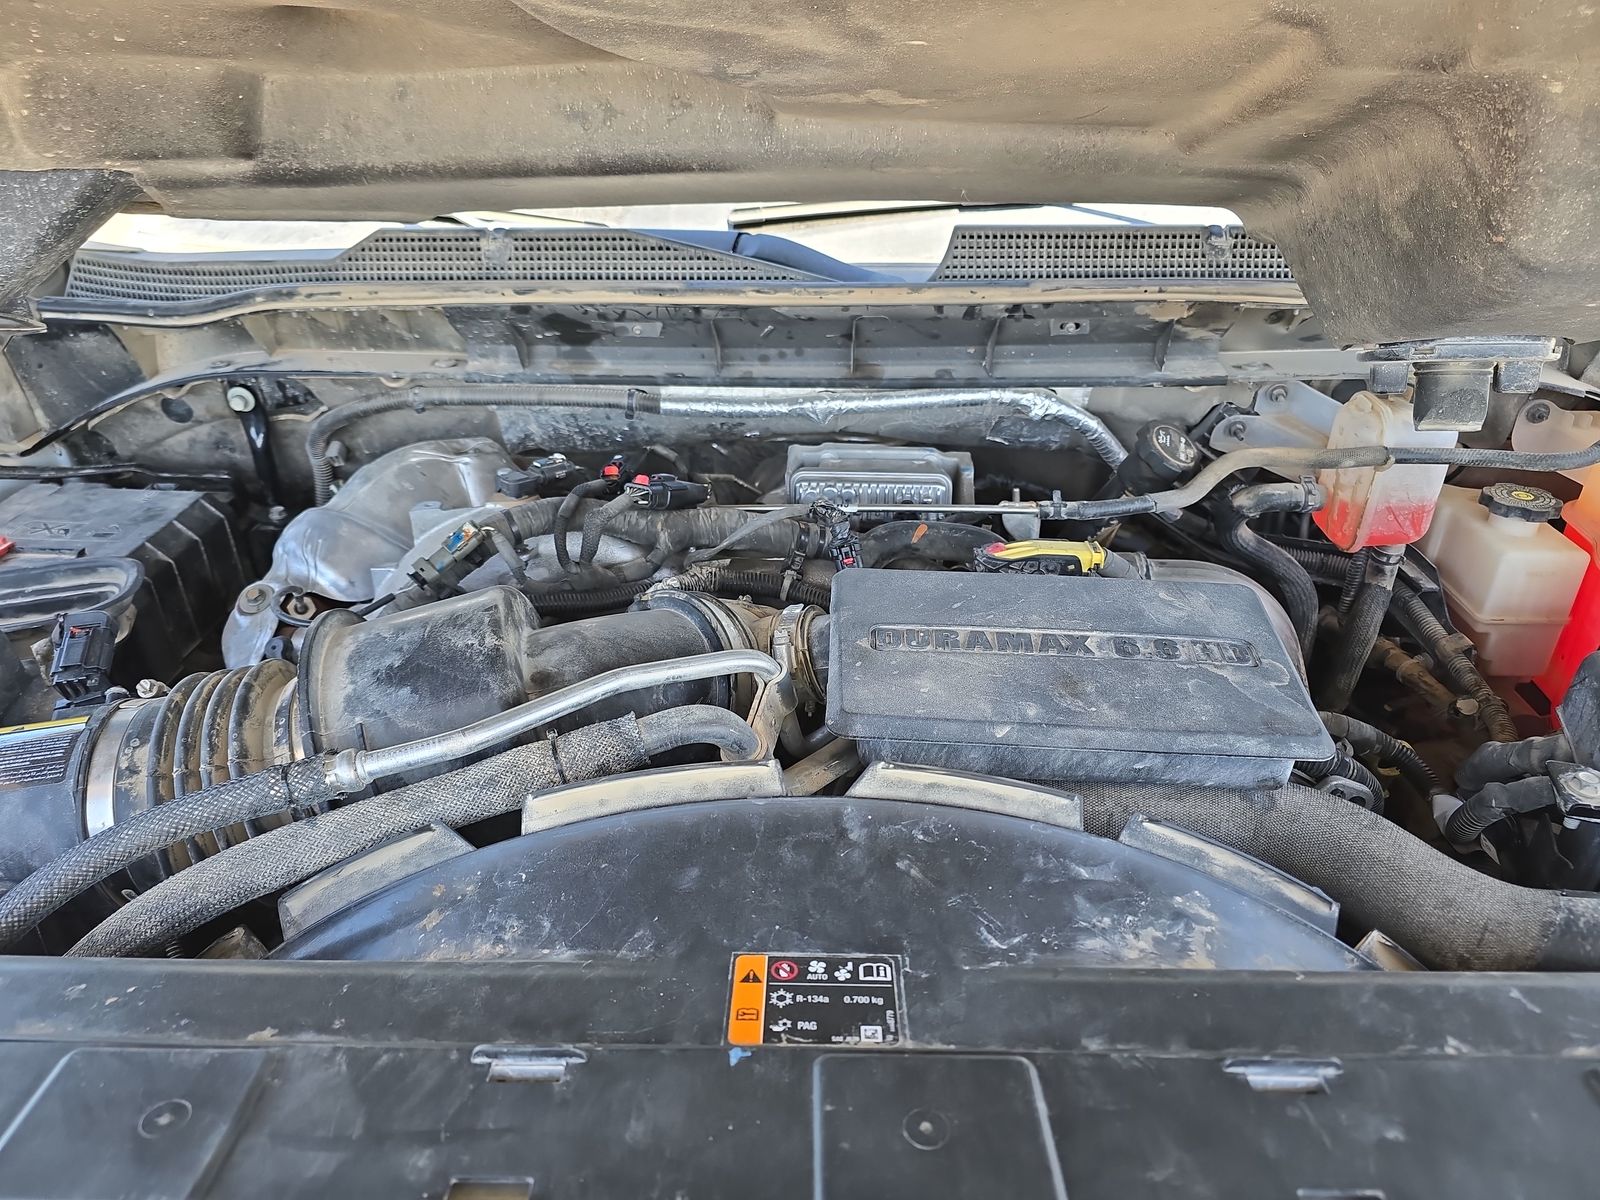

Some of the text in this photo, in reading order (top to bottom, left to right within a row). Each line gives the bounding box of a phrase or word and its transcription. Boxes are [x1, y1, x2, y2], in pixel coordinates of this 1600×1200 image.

[875, 628, 1095, 656] DURAMAX
[795, 995, 884, 1006] R-134a 0.700 kg
[797, 1021, 818, 1031] PAG
